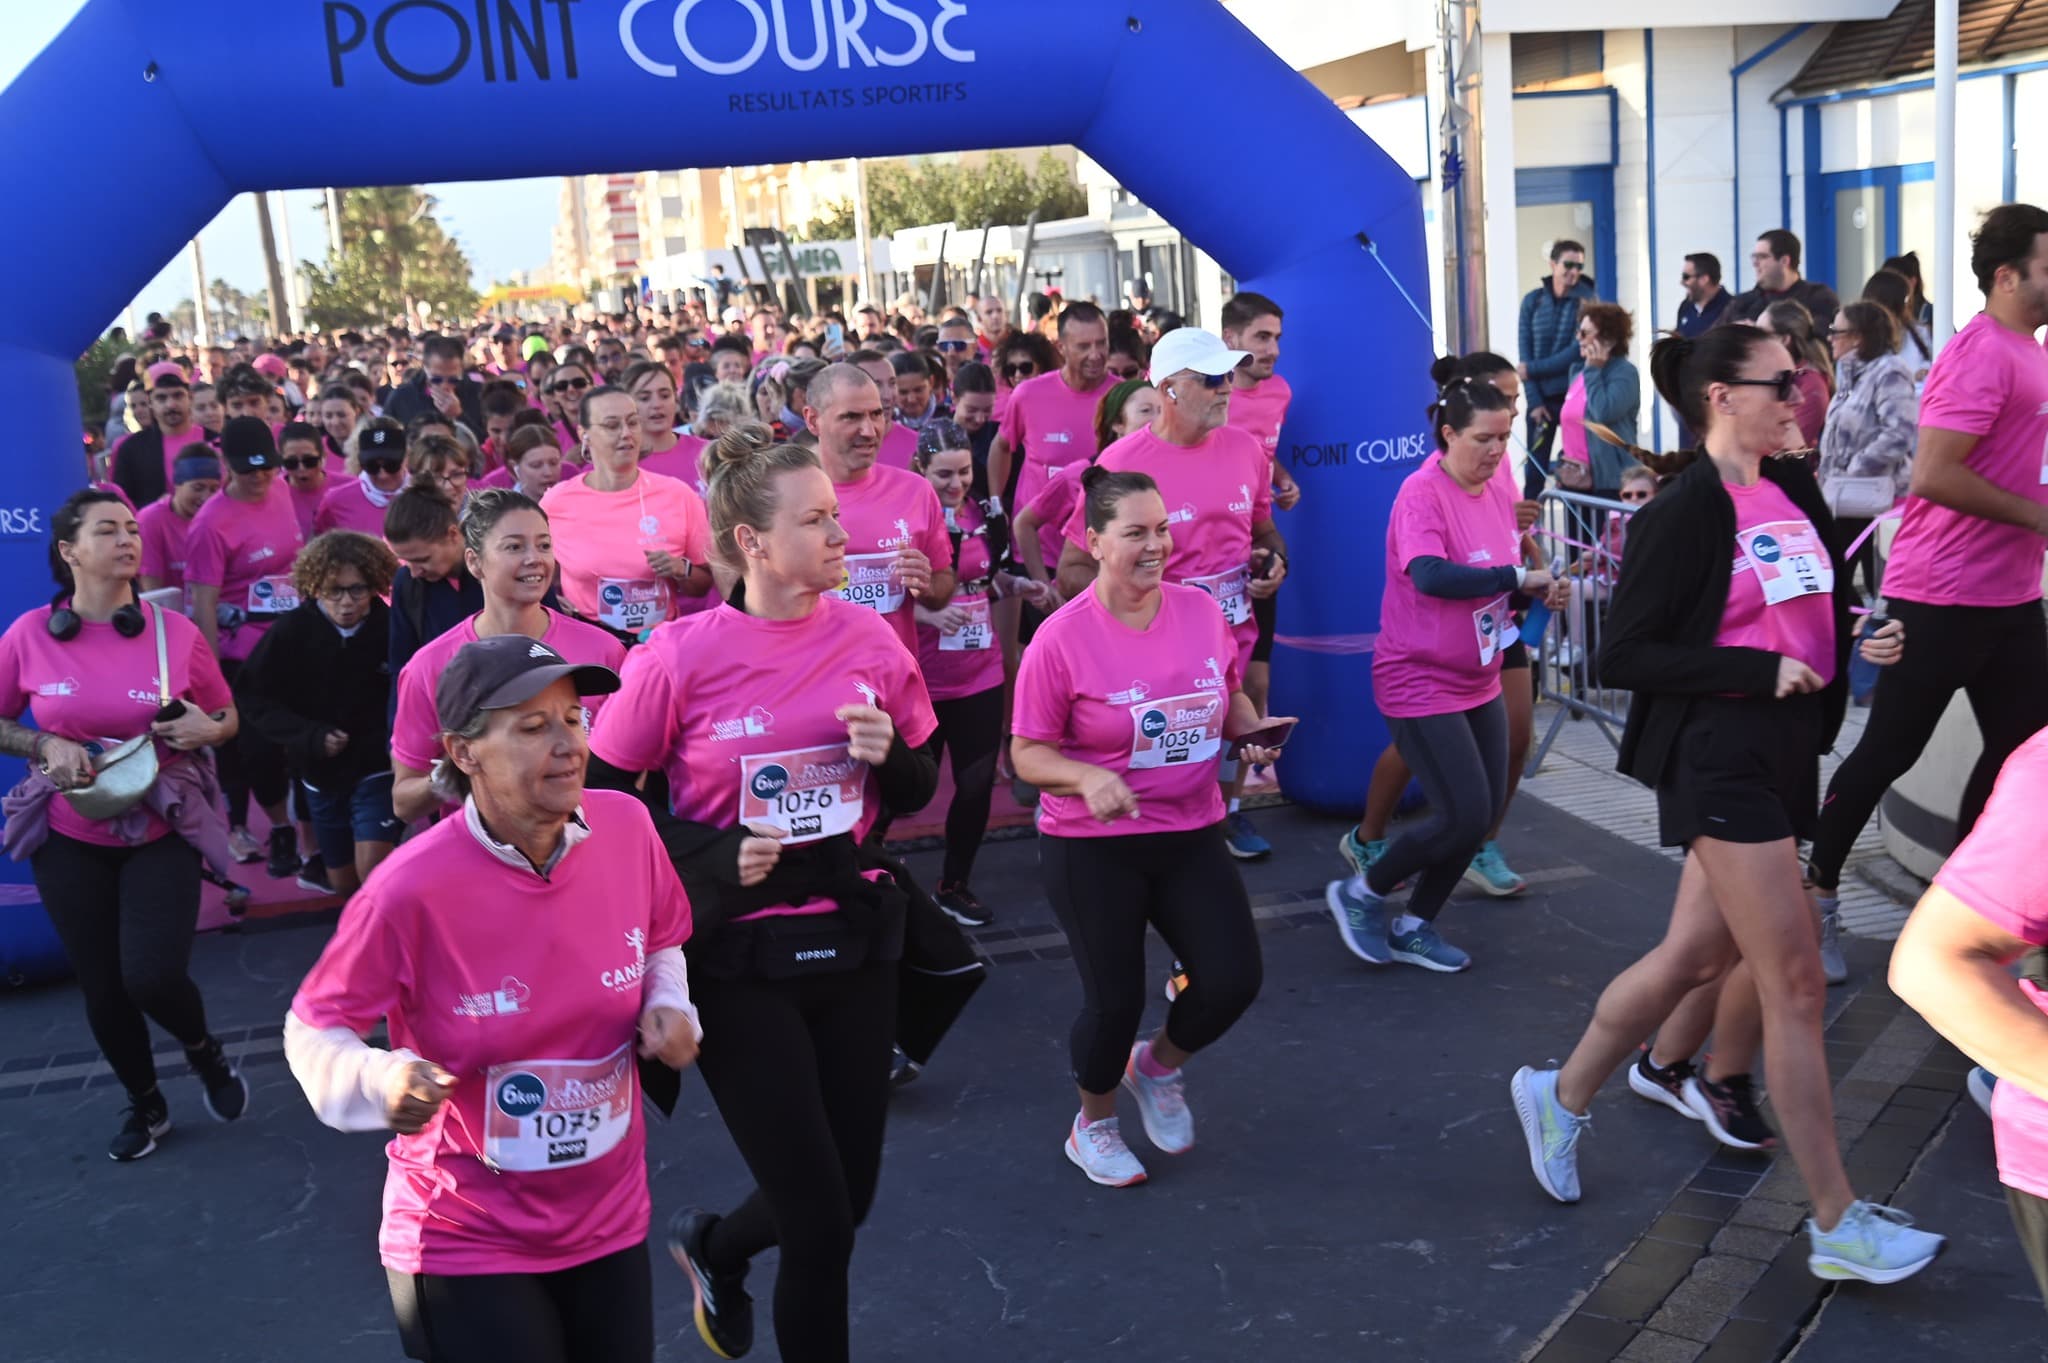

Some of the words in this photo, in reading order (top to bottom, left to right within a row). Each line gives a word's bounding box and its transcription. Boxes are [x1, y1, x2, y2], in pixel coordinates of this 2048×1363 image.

[323, 0, 582, 88] POINT
[618, 0, 976, 77] COURSE
[728, 87, 855, 113] RESULTATS
[861, 82, 967, 107] SPORTIFS
[1291, 443, 1348, 468] POINT
[1355, 432, 1426, 464] COURSE
[841, 583, 886, 602] 3088
[620, 602, 649, 617] 206
[962, 624, 983, 638] 242
[1175, 707, 1210, 723] Rose
[1159, 729, 1201, 749] 1036
[754, 774, 786, 792] 6km
[775, 788, 833, 815] 1076
[795, 949, 836, 961] KIPRUN
[502, 1083, 542, 1106] 6km
[533, 1107, 601, 1139] 1075
